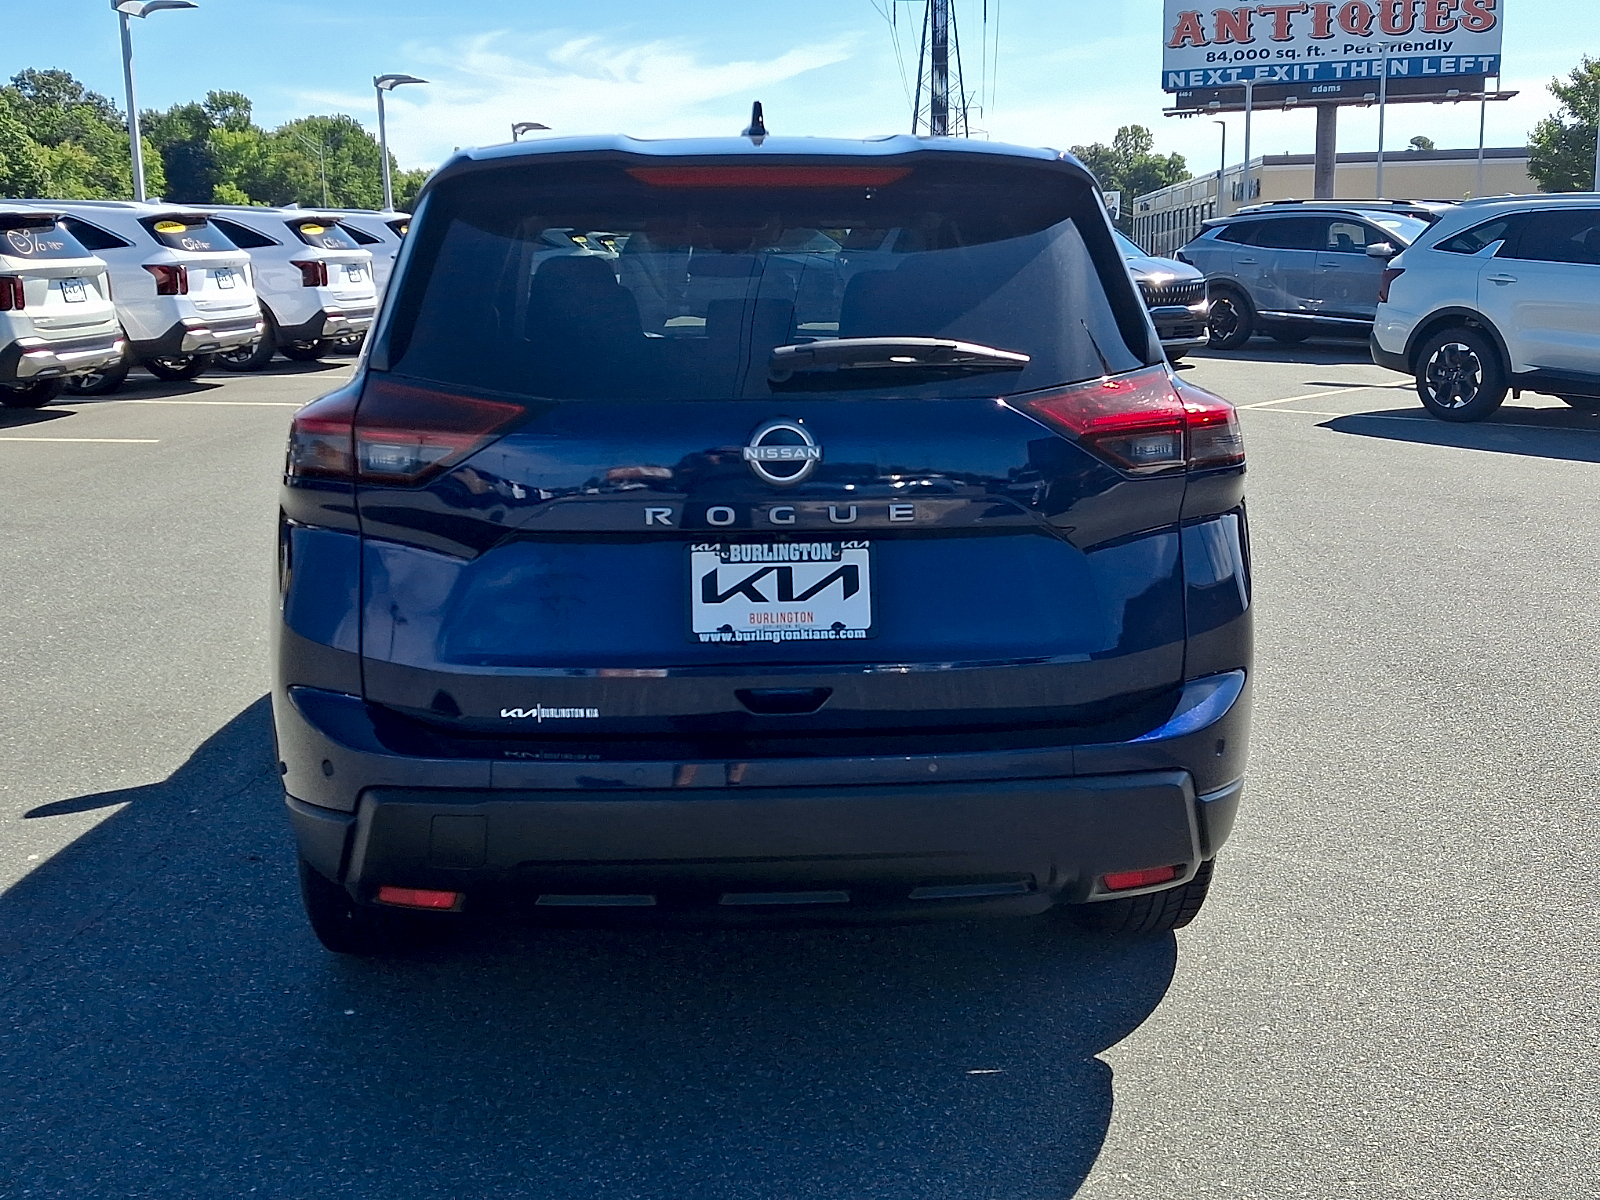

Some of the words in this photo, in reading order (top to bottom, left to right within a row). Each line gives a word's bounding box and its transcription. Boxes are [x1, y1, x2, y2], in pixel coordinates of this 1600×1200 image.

[1166, 0, 1497, 47] ANTIQUES
[1206, 48, 1270, 63] 84,000
[1276, 48, 1300, 60] sq.
[1307, 45, 1325, 57] ft.
[1343, 43, 1373, 54] Pet
[1168, 68, 1242, 88] NEXT
[1254, 64, 1319, 82] EXIT
[1331, 59, 1409, 78] THEN
[1422, 57, 1495, 74] LEFT
[1311, 84, 1341, 93] adams
[745, 448, 820, 460] NISSAN
[645, 504, 915, 526] ROGUE
[729, 543, 833, 562] BURLINGTON
[702, 564, 860, 604] KIA
[749, 612, 814, 624] BURLINGTON
[699, 629, 867, 643] www.burlingtonkianc.com
[500, 708, 538, 719] KIA
[541, 708, 585, 719] BURLINGTON
